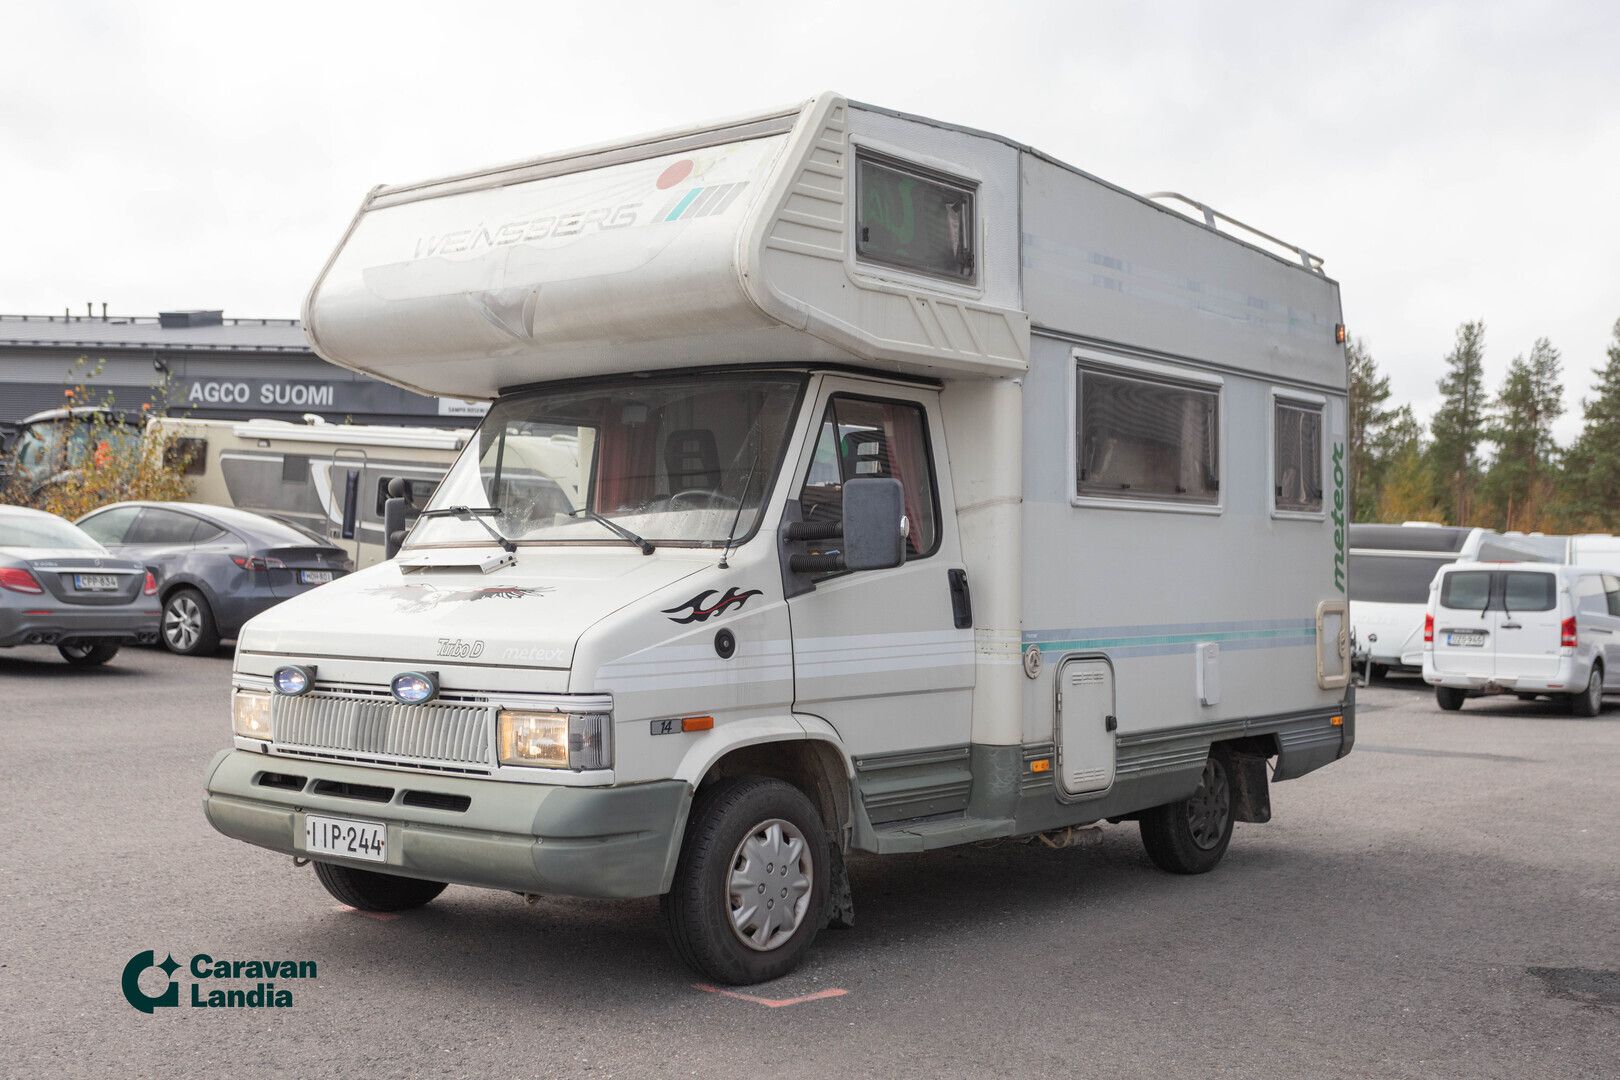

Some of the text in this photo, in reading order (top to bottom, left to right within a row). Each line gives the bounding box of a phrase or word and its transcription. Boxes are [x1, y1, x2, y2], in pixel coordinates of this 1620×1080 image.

[414, 202, 643, 258] WEINSBERG
[189, 381, 334, 406] AGCO SUOMI
[1331, 442, 1345, 594] meteor
[312, 821, 381, 856] IIP-244
